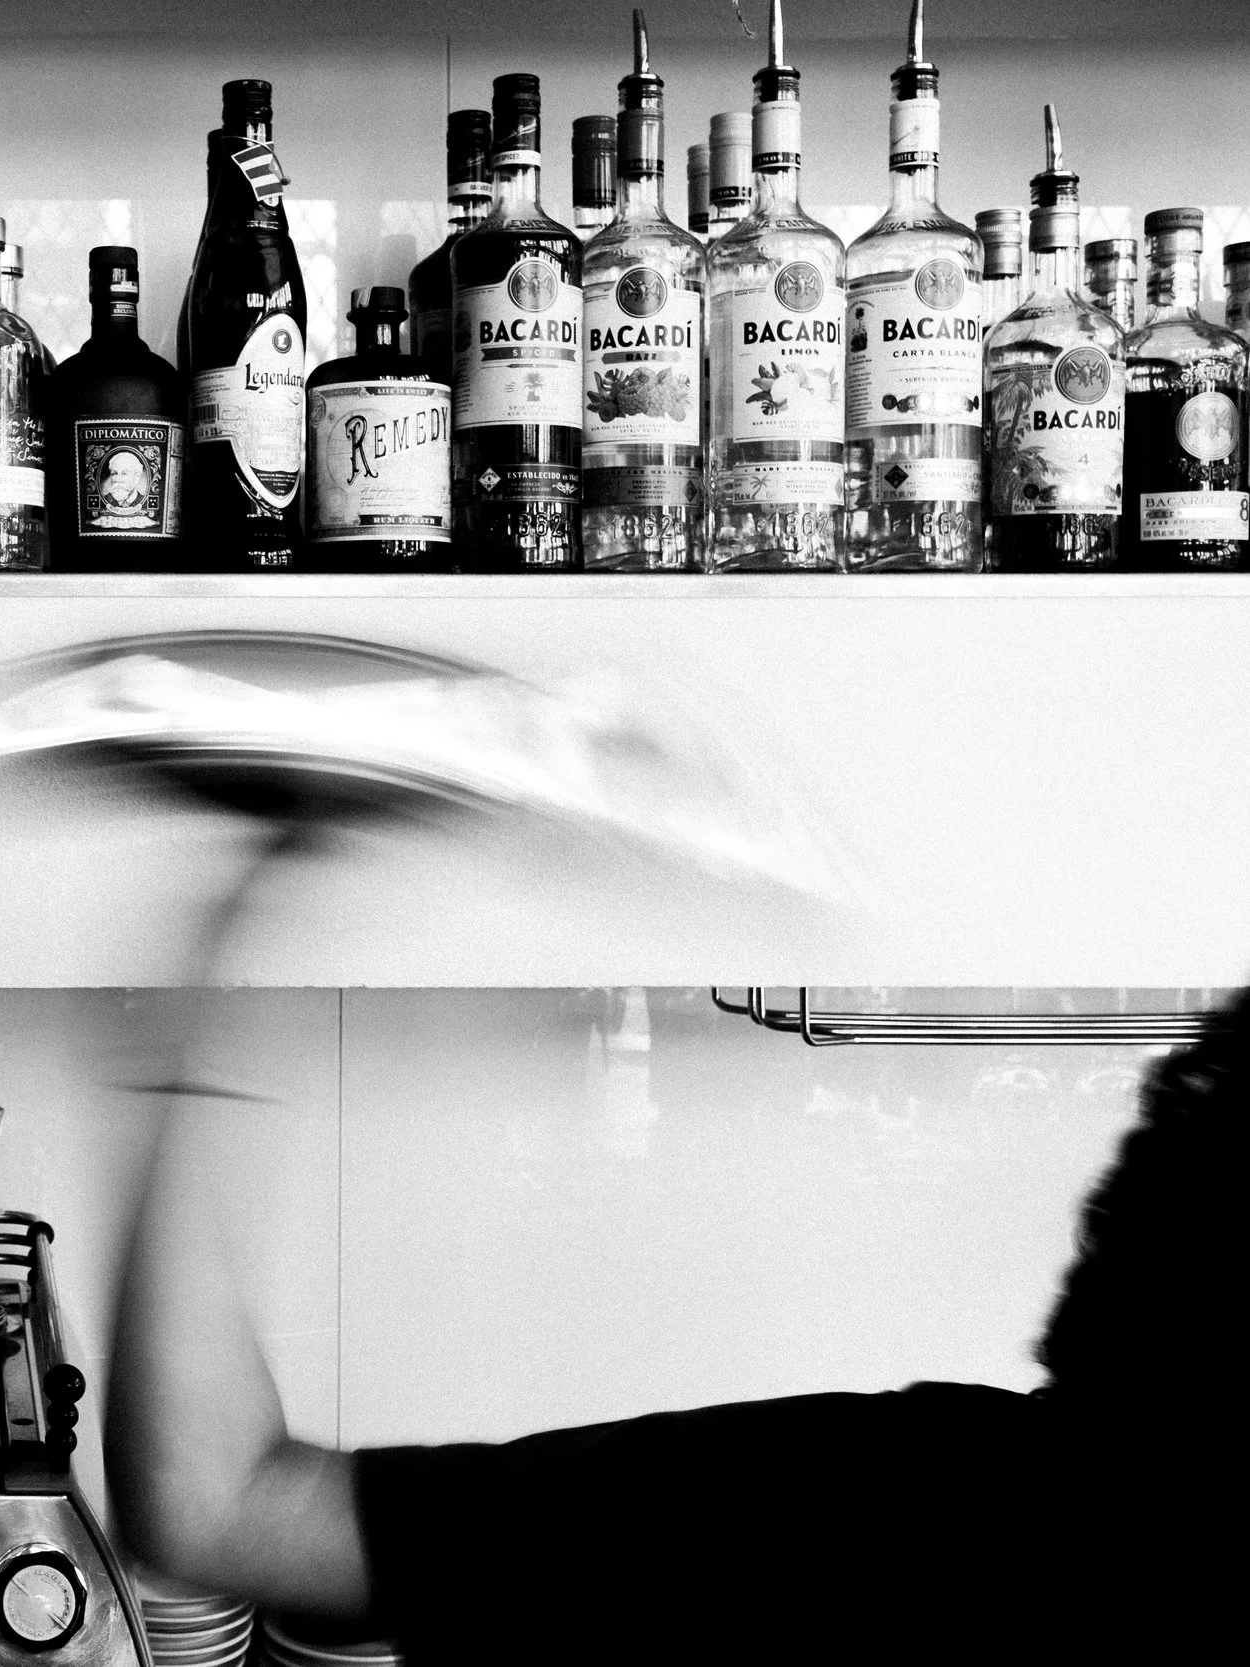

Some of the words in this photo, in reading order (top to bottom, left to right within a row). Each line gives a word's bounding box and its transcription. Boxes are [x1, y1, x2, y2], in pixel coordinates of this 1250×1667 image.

[479, 316, 578, 344] BACARDÍ
[590, 320, 692, 351] BACARDÍ
[743, 317, 841, 345] BACARDÍ
[882, 315, 981, 342] BACARDÍ
[893, 349, 934, 358] CARTA
[1033, 406, 1121, 431] BACARDÍ
[85, 428, 164, 440] DIPLOMÁTICO
[344, 406, 449, 486] REMEDY
[507, 471, 561, 480] ESTABLECIDO
